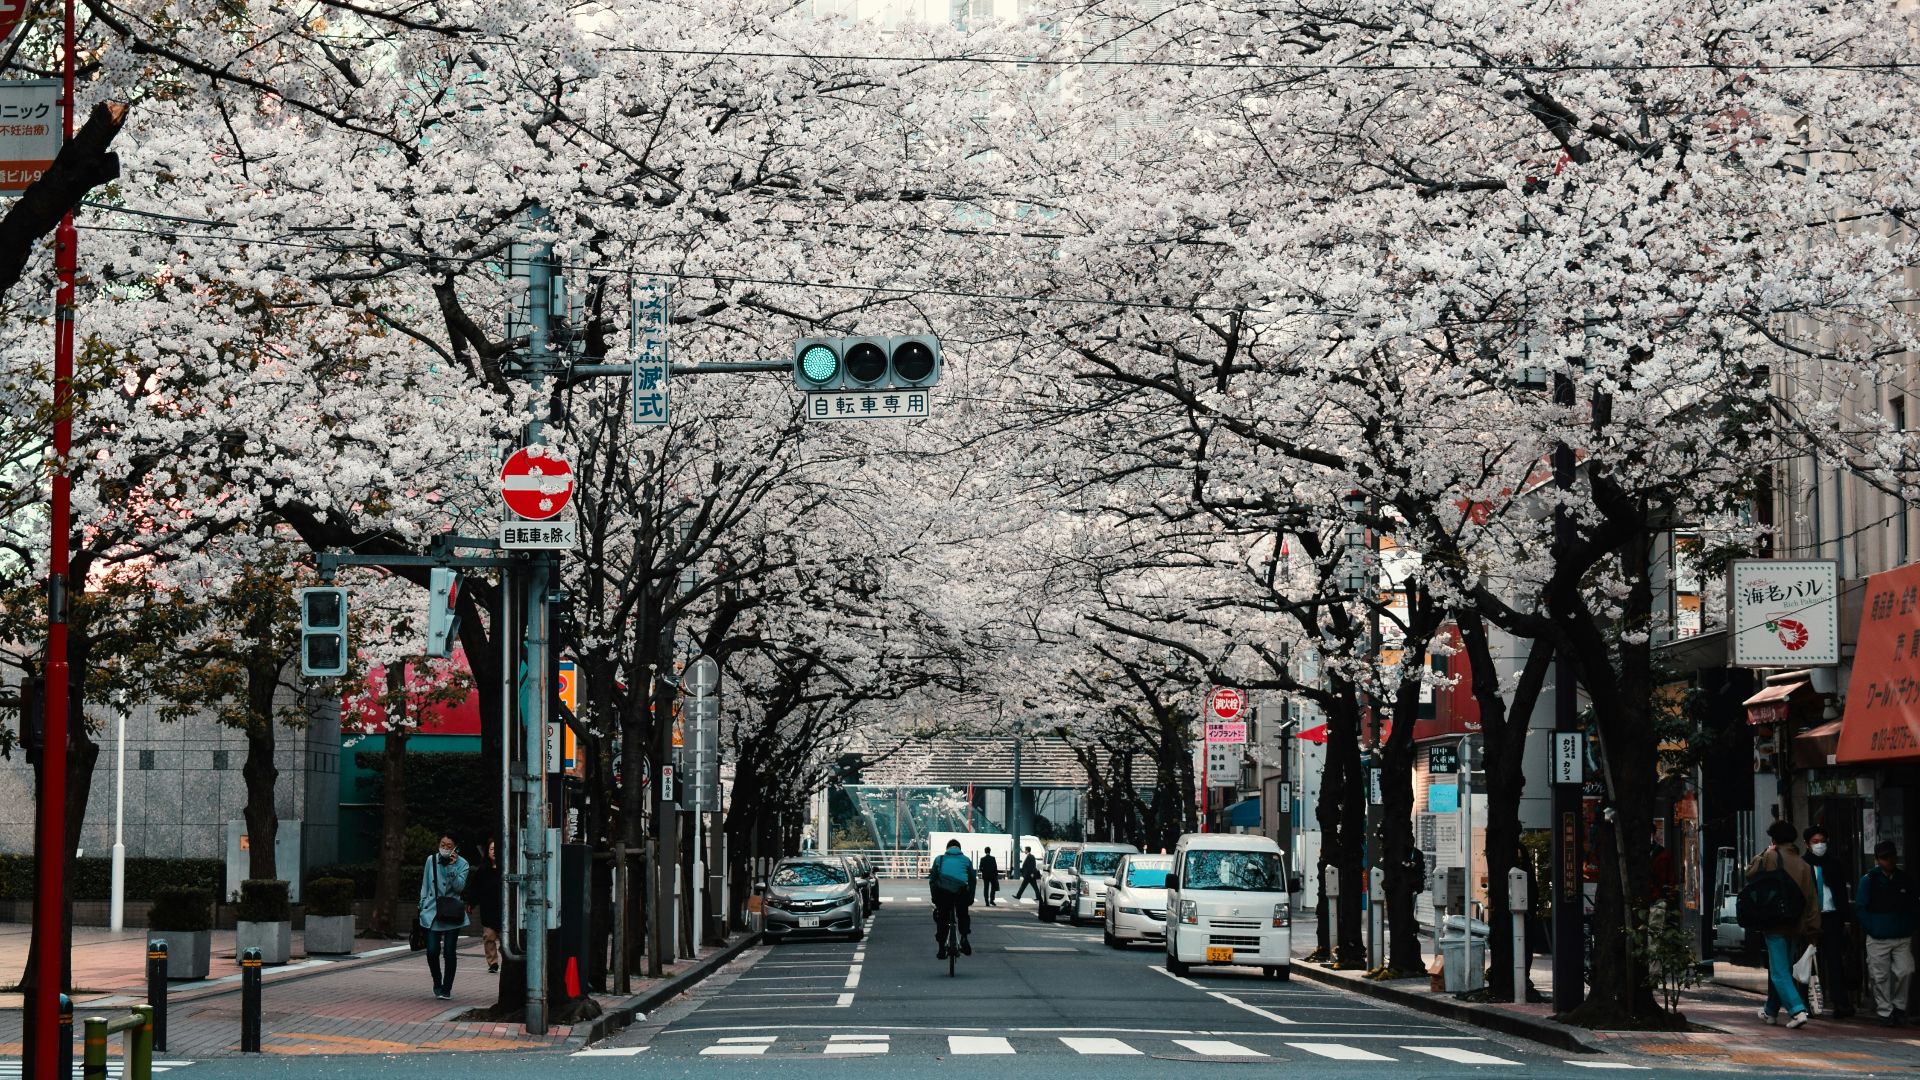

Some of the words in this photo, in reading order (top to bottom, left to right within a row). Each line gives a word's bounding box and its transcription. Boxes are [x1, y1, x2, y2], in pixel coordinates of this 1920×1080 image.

[0, 103, 49, 119] ニック
[0, 169, 45, 183] ビル9
[815, 395, 924, 415] 自転車専用
[504, 528, 571, 543] 自転車を除く
[1743, 579, 1823, 606] 海老バル
[1215, 698, 1238, 710] 消火栓
[1208, 730, 1237, 738] インプラント
[1211, 952, 1232, 960] 52-54
